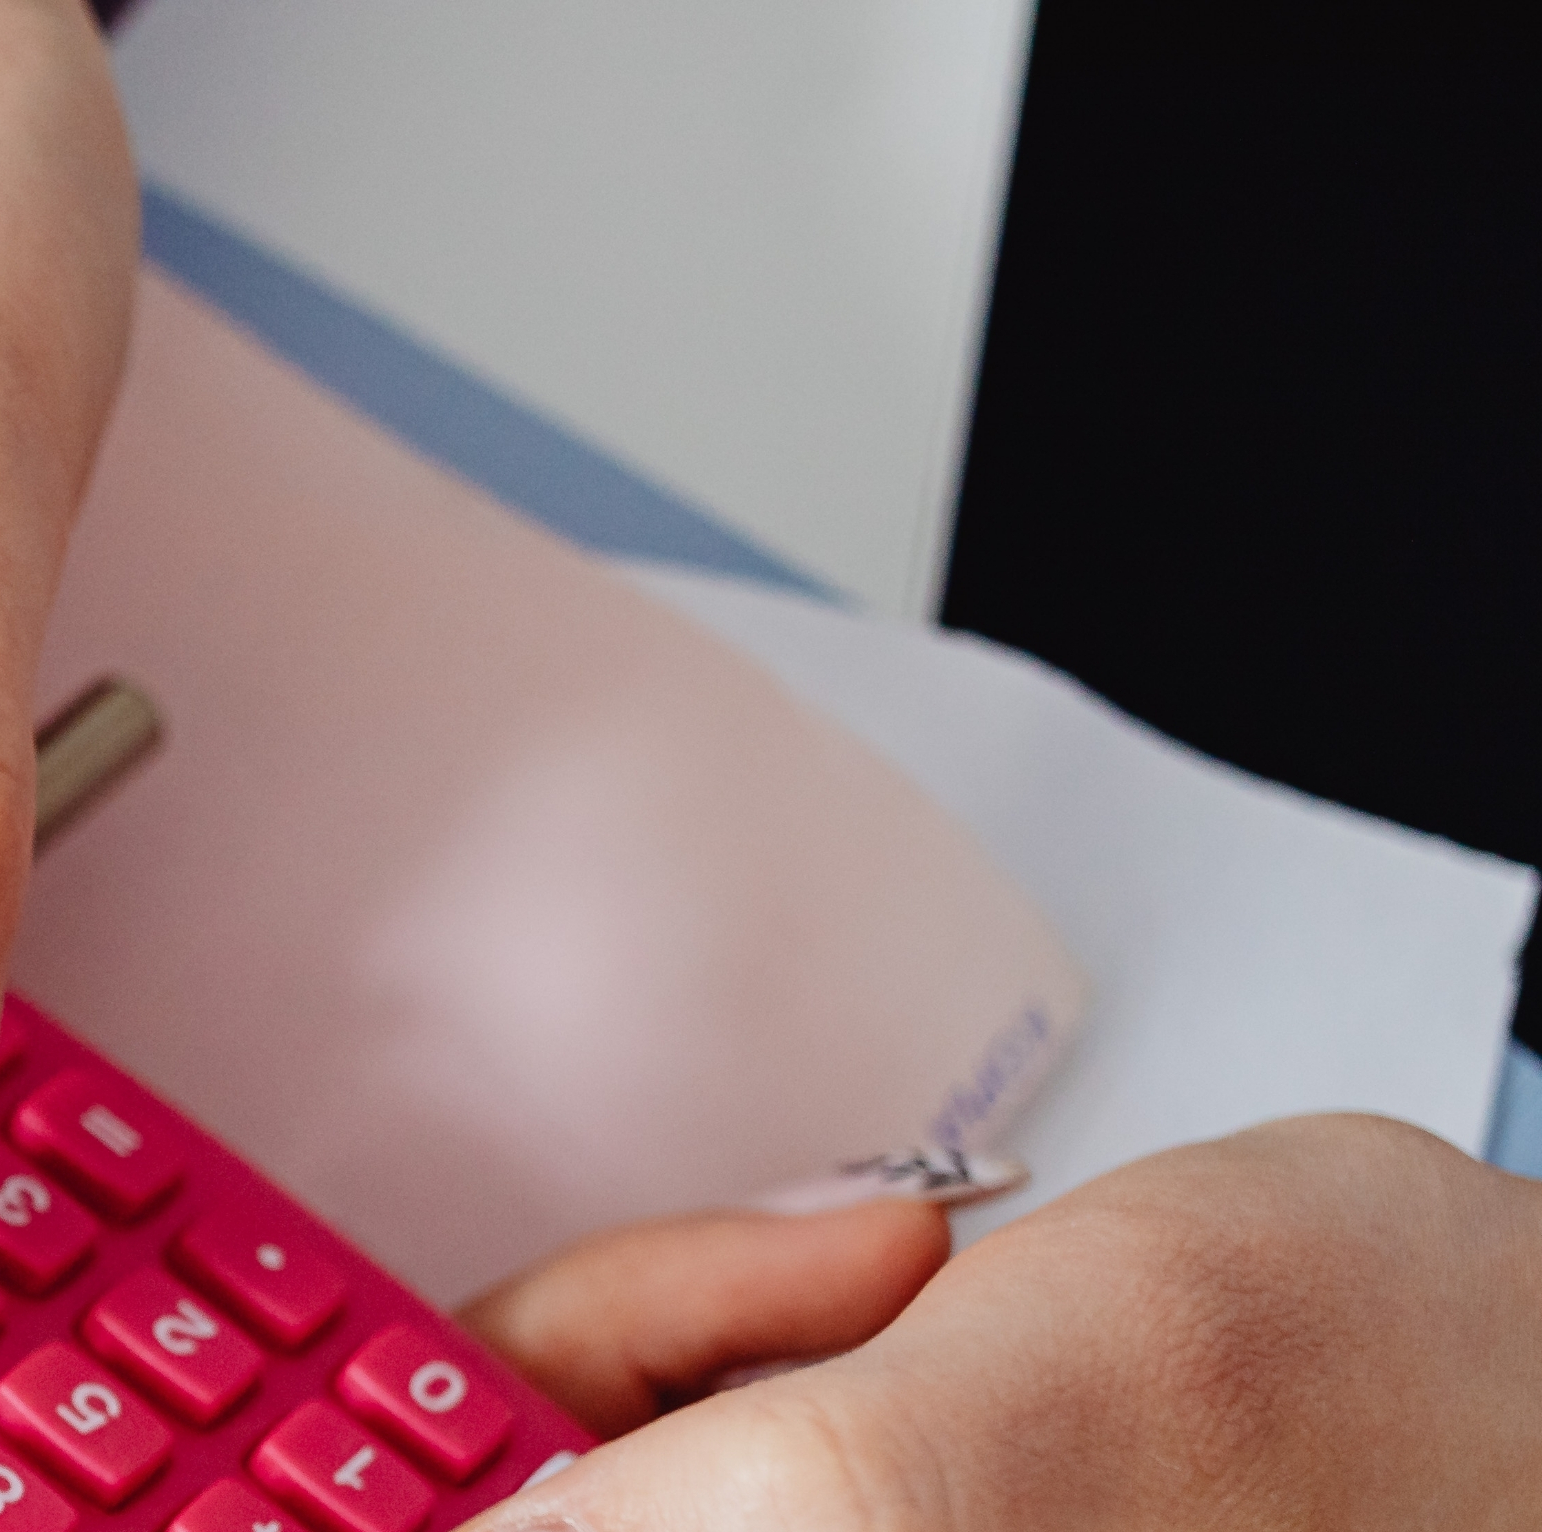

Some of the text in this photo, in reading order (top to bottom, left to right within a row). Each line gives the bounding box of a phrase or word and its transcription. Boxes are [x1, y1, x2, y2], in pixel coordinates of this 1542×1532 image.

[152, 1300, 217, 1356] 2
[56, 1383, 120, 1434] 5
[408, 1361, 467, 1413] 0
[333, 1445, 375, 1491] 1
